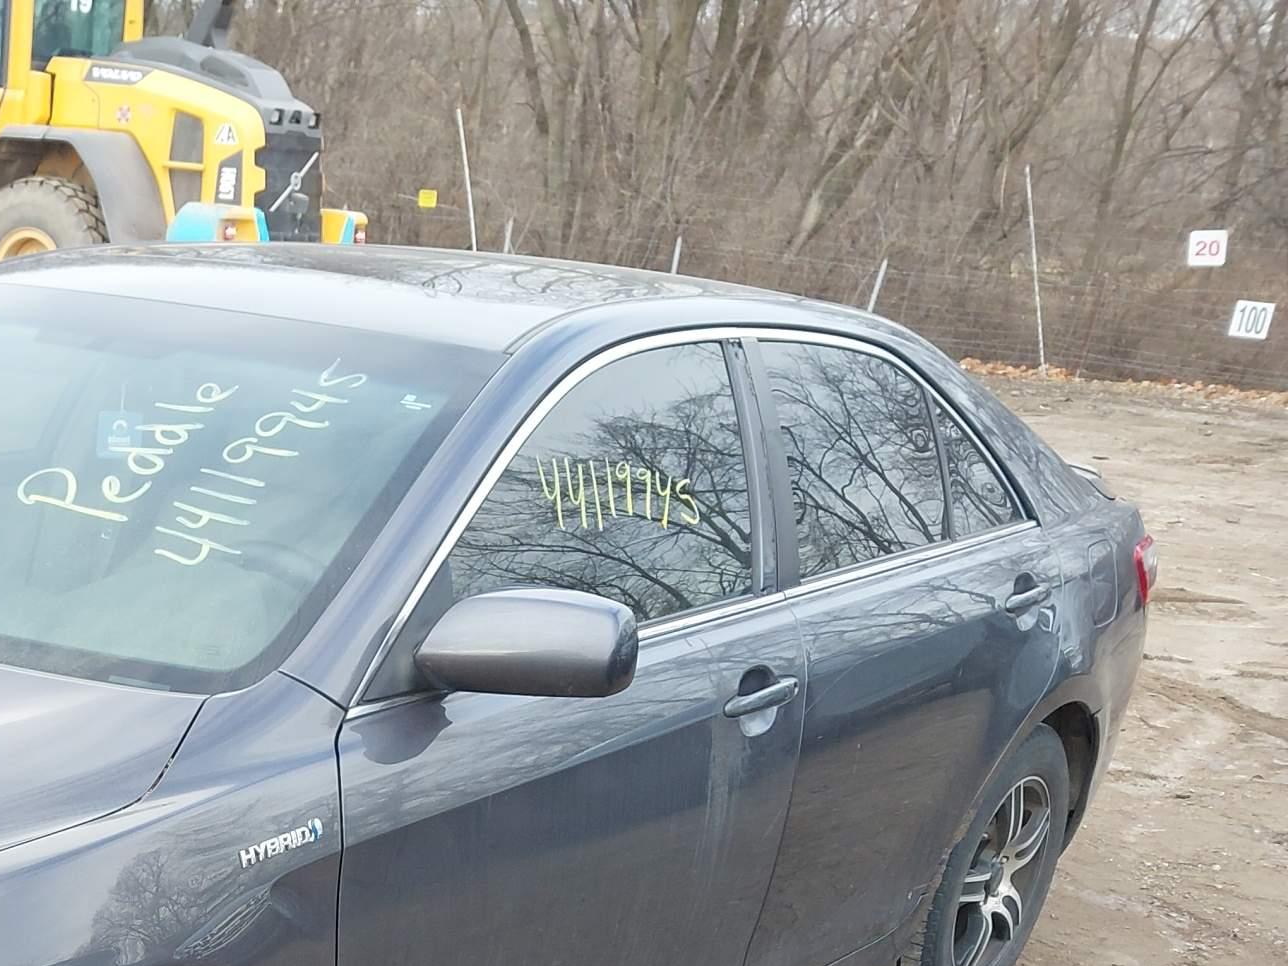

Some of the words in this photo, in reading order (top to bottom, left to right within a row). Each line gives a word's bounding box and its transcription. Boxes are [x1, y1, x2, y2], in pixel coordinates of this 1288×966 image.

[1195, 241, 1220, 256] 20
[1237, 305, 1268, 335] 100
[16, 381, 239, 522] Peddle
[153, 358, 368, 567] 44119945
[535, 454, 700, 532] 44119945
[239, 826, 311, 868] HYBRID
